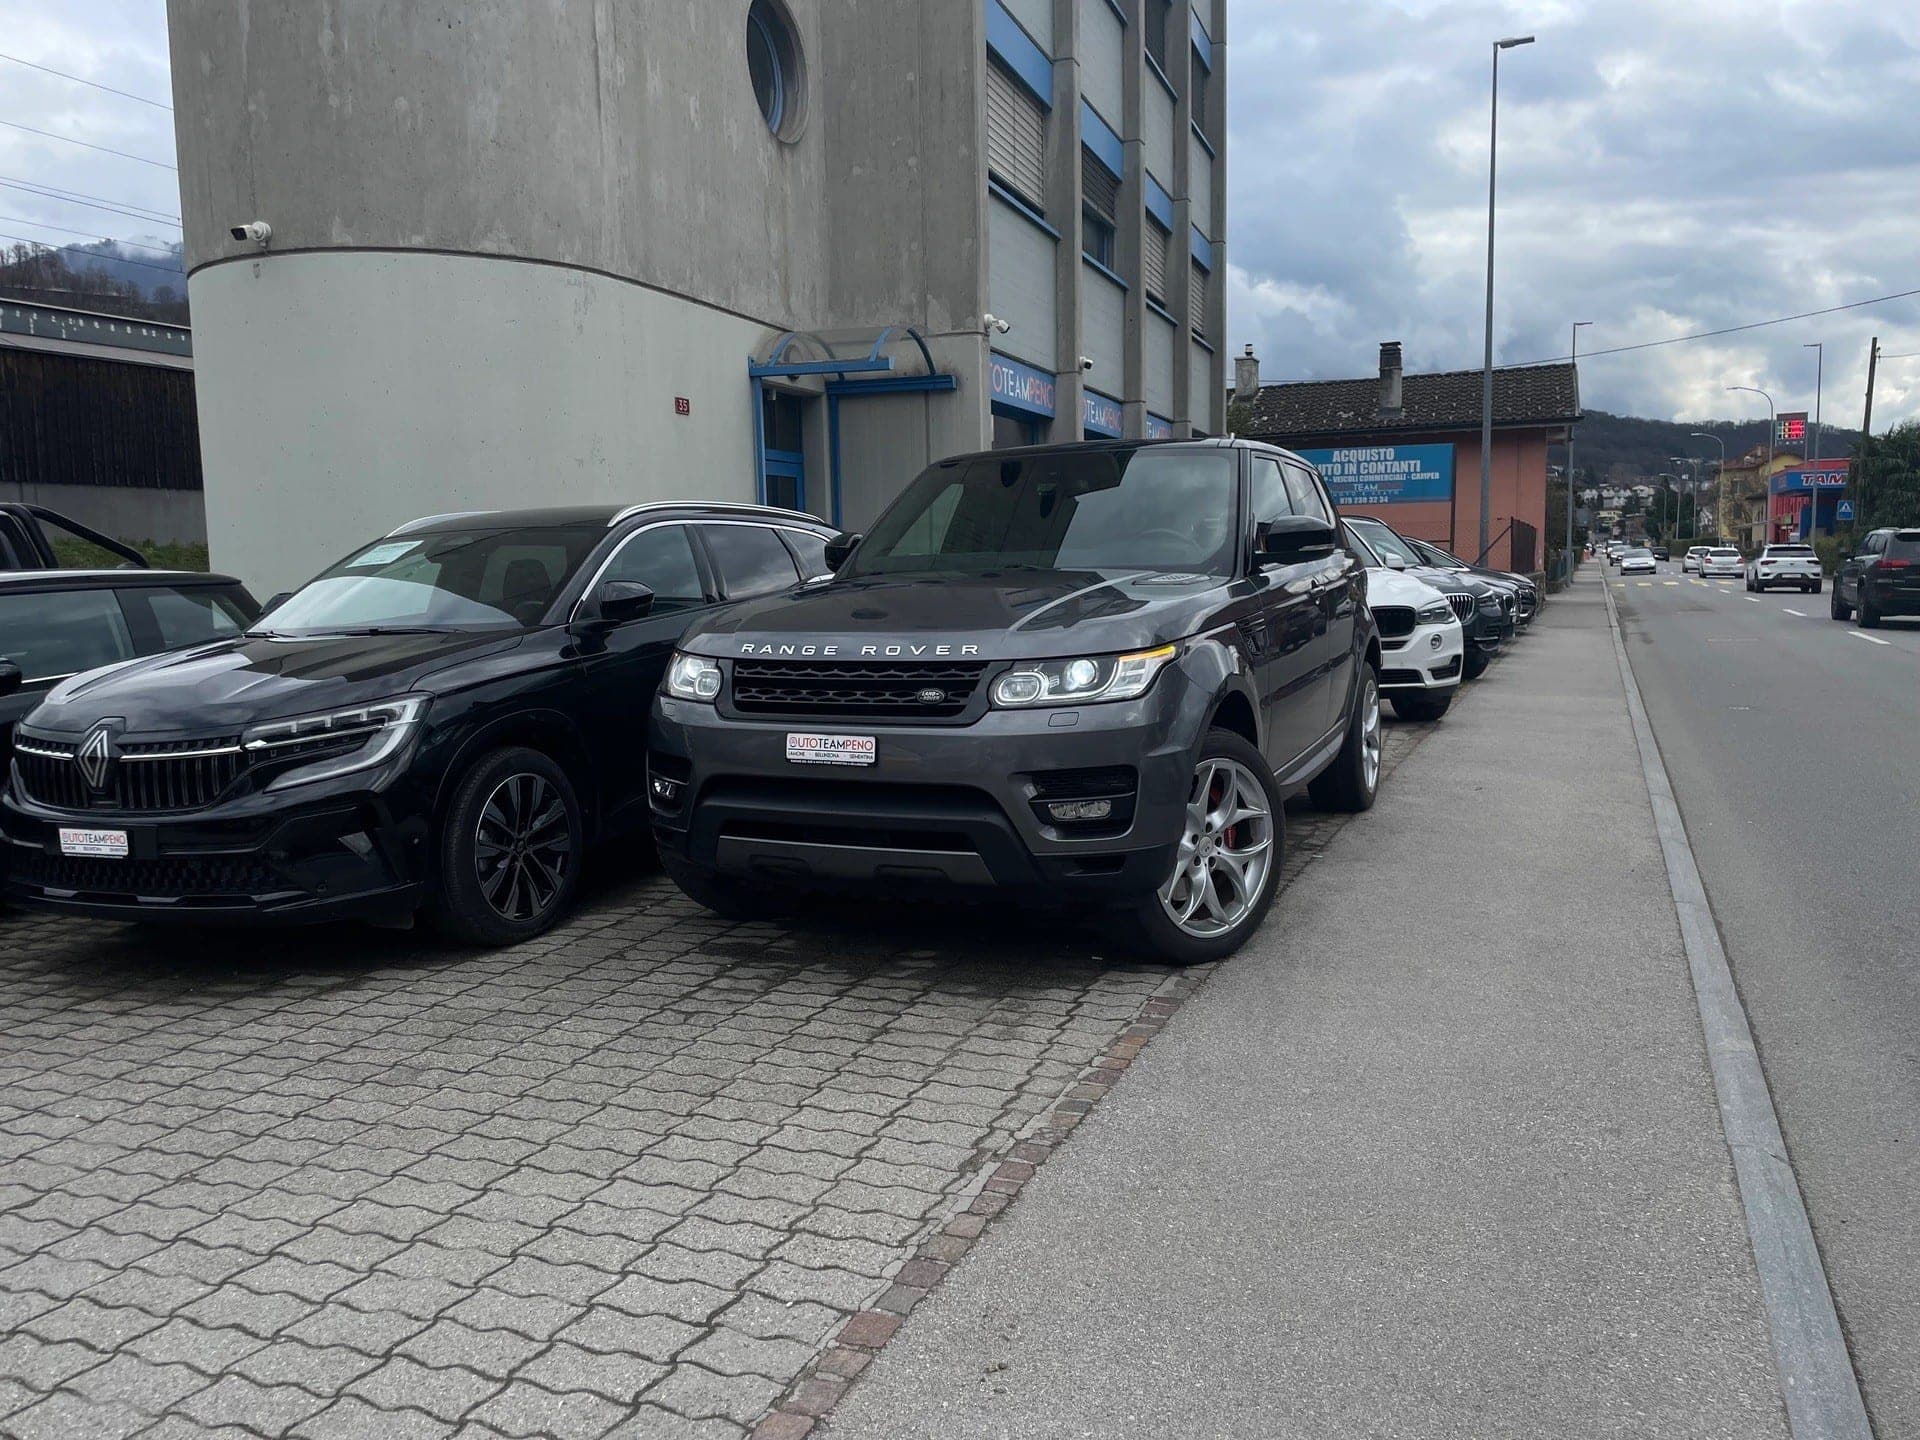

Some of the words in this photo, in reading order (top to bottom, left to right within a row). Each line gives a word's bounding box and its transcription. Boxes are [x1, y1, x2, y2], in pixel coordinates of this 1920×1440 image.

[991, 361, 1054, 409] OTEAMPENO
[678, 399, 688, 411] 35
[1332, 448, 1395, 463] ACQUISTO
[1316, 463, 1341, 476] UTO
[1344, 462, 1357, 475] IN
[1360, 460, 1421, 474] CONTANTI
[1333, 475, 1358, 483] VEICOLI
[1411, 472, 1440, 480] CAMPER
[741, 643, 838, 655] RANGE
[861, 644, 980, 656] ROVER
